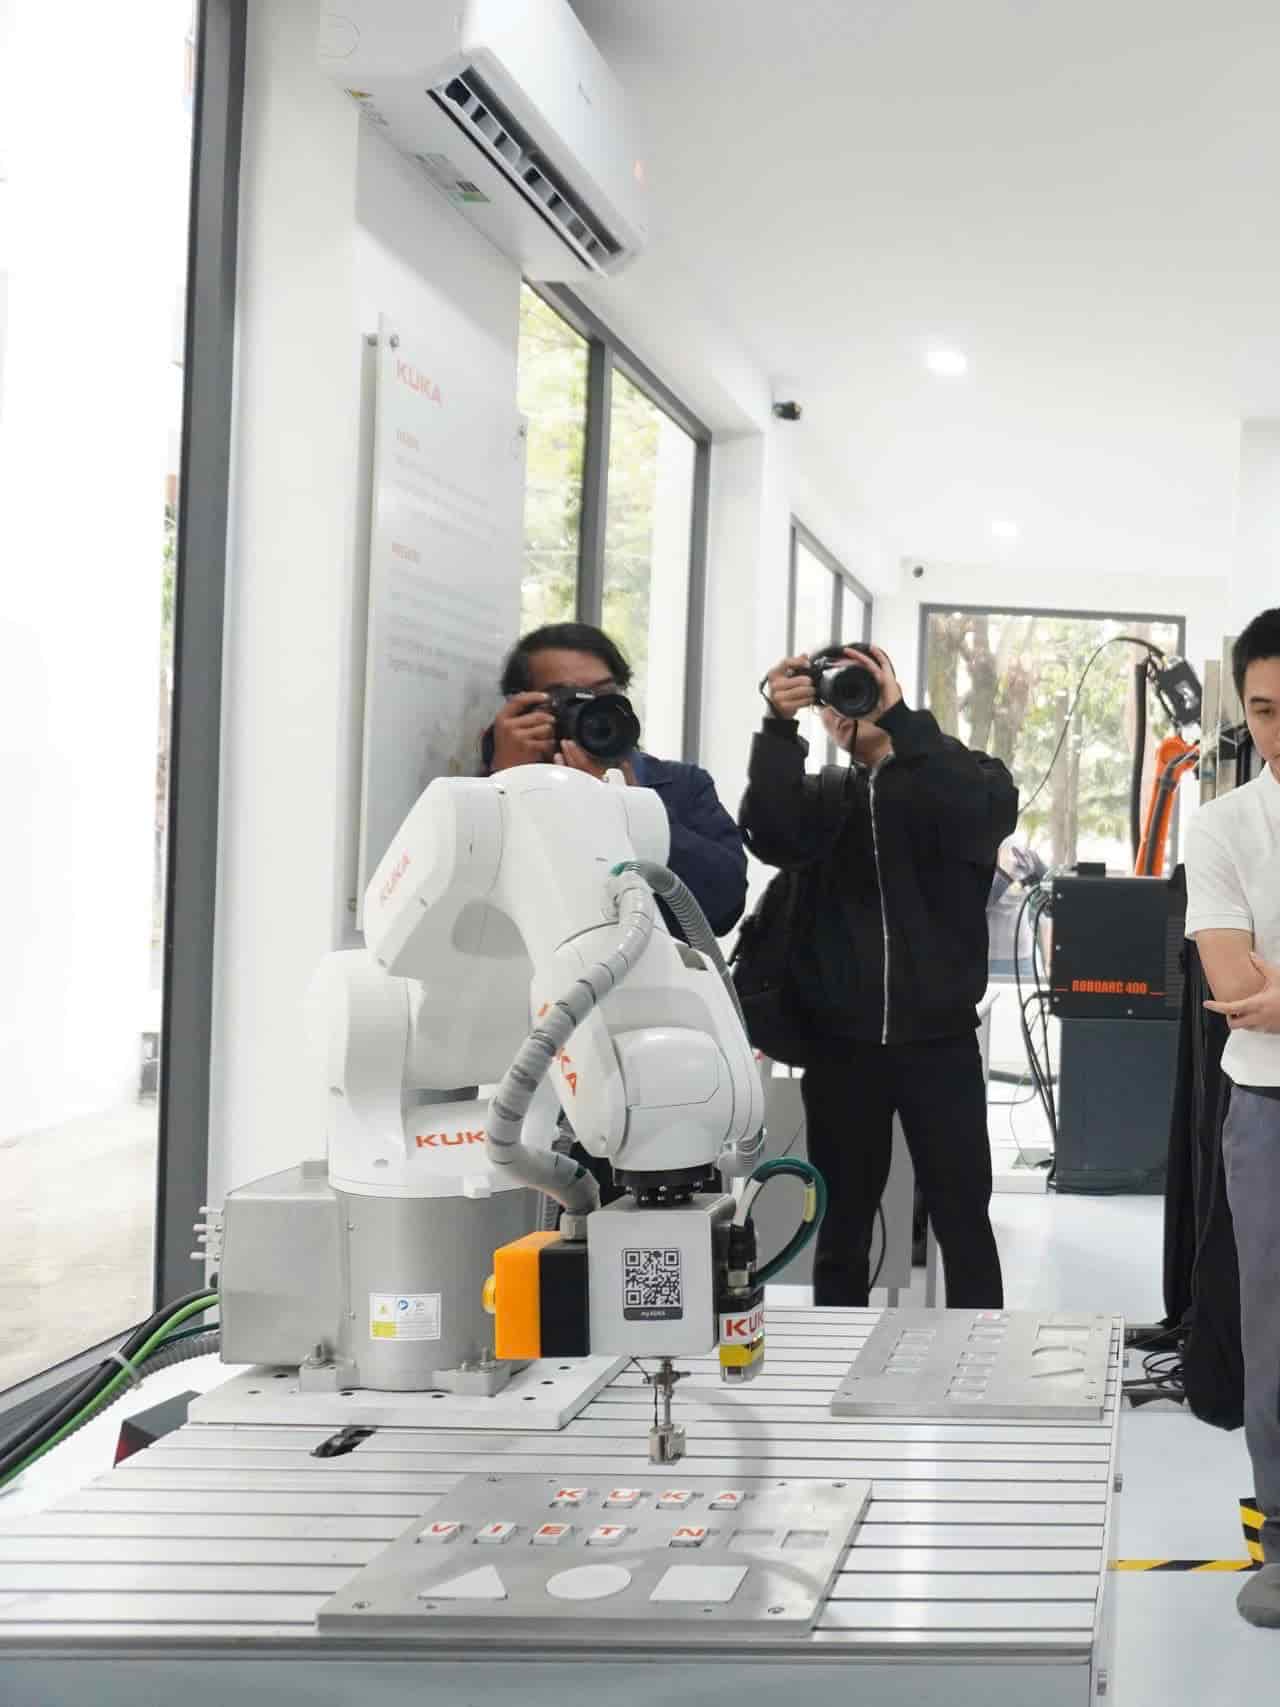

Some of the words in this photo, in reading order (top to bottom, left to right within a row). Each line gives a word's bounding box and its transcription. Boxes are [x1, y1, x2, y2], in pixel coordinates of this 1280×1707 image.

[394, 357, 447, 408] KUKA
[415, 1129, 486, 1148] KUK
[725, 1310, 766, 1337] KUK
